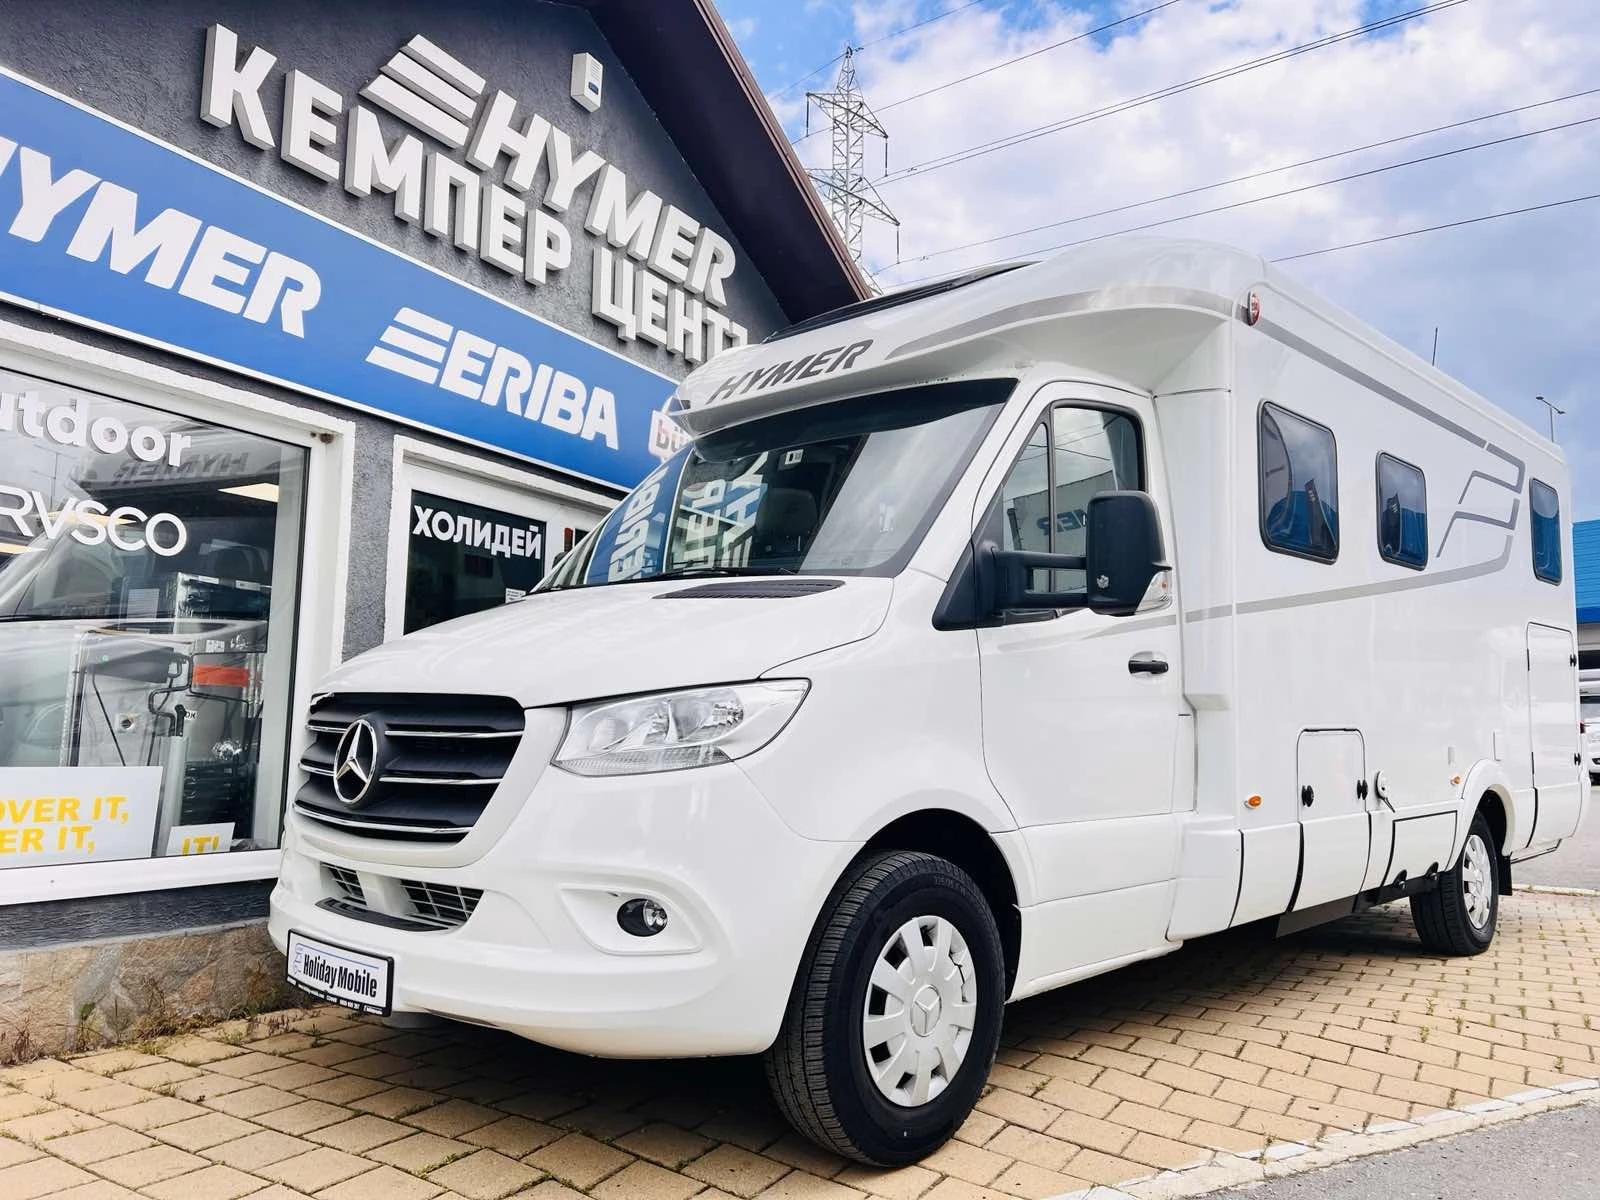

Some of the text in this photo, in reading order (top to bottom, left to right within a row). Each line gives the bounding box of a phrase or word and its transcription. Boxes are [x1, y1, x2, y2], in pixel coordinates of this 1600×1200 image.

[201, 23, 748, 363] КЕМПЕР ЦЕНТ
[467, 89, 735, 307] HYMER
[0, 136, 619, 450] YMER ERIBA
[706, 339, 873, 405] HYMER
[413, 505, 541, 559] ХОЛИДЕЙ
[0, 797, 129, 825] VER IT,
[57, 826, 96, 855] IT,
[303, 954, 337, 989] Holiday
[337, 966, 377, 998] Mobile
